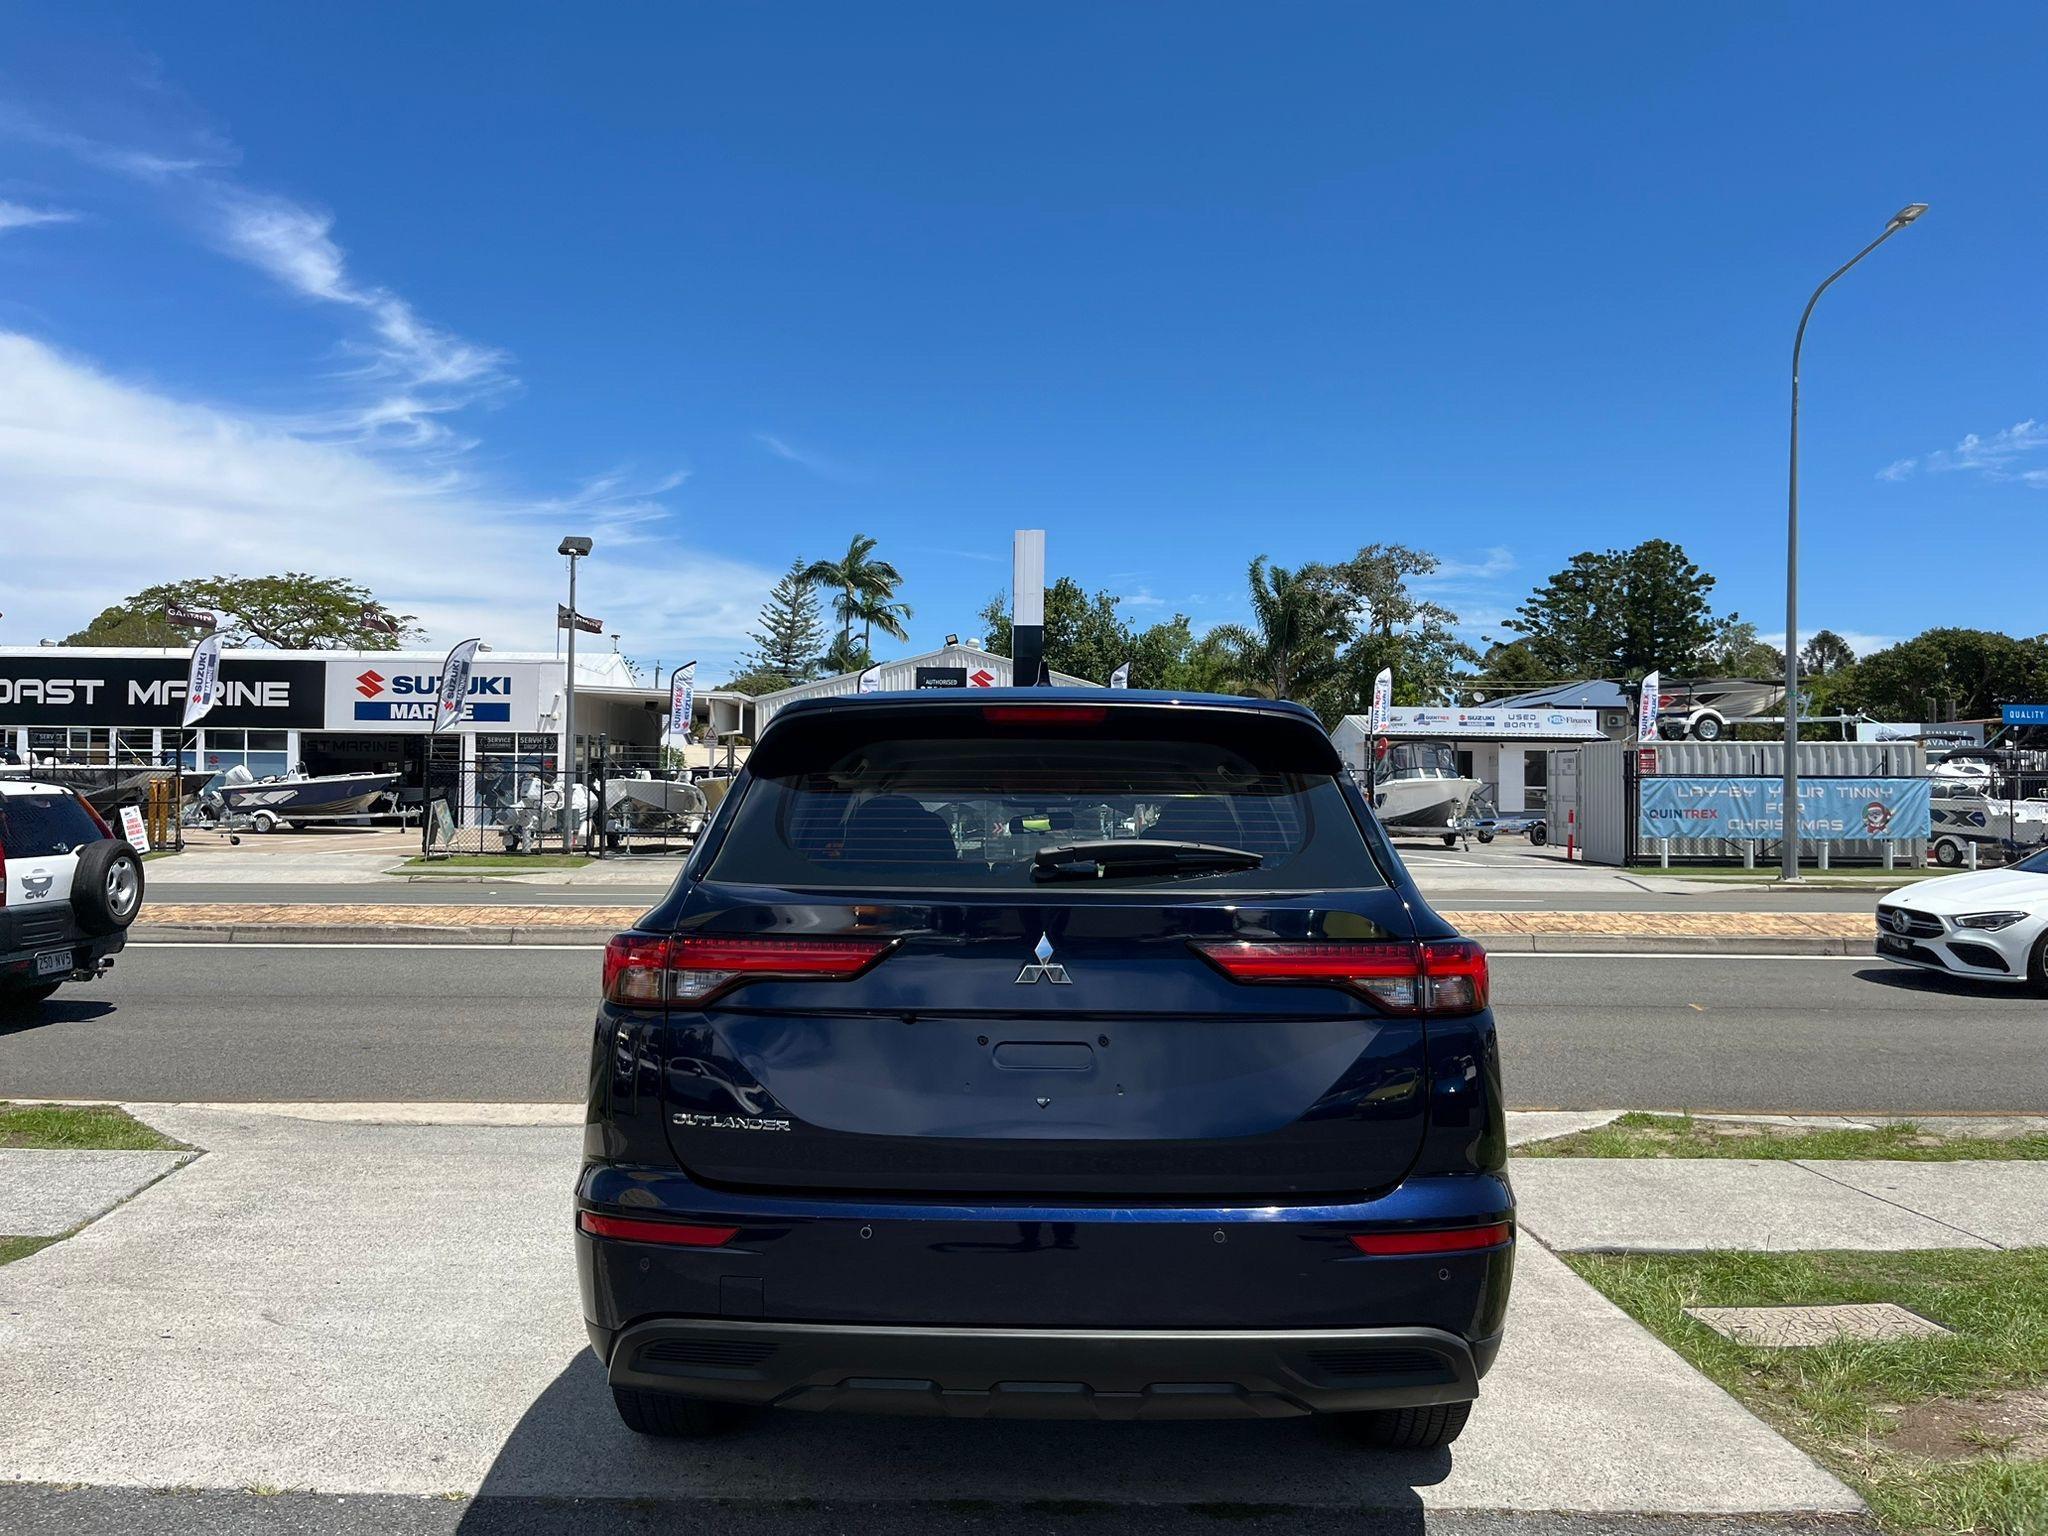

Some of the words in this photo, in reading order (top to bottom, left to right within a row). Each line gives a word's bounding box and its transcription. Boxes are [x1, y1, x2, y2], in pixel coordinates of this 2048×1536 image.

[194, 652, 208, 693] SUZUKI
[446, 659, 461, 699] SUZUKI
[391, 675, 511, 695] SUUKI
[390, 704, 474, 719] MARE
[1507, 713, 1537, 721] USED
[2009, 710, 2044, 719] QUALITY
[1677, 786, 1757, 798] LAY-BY
[1768, 786, 1824, 798] YUR
[1836, 786, 1893, 799] TINNY
[1649, 809, 1718, 820] QUINTREX
[1728, 819, 1844, 831] CHRISMAS
[672, 1113, 791, 1131] OUTLANDER
